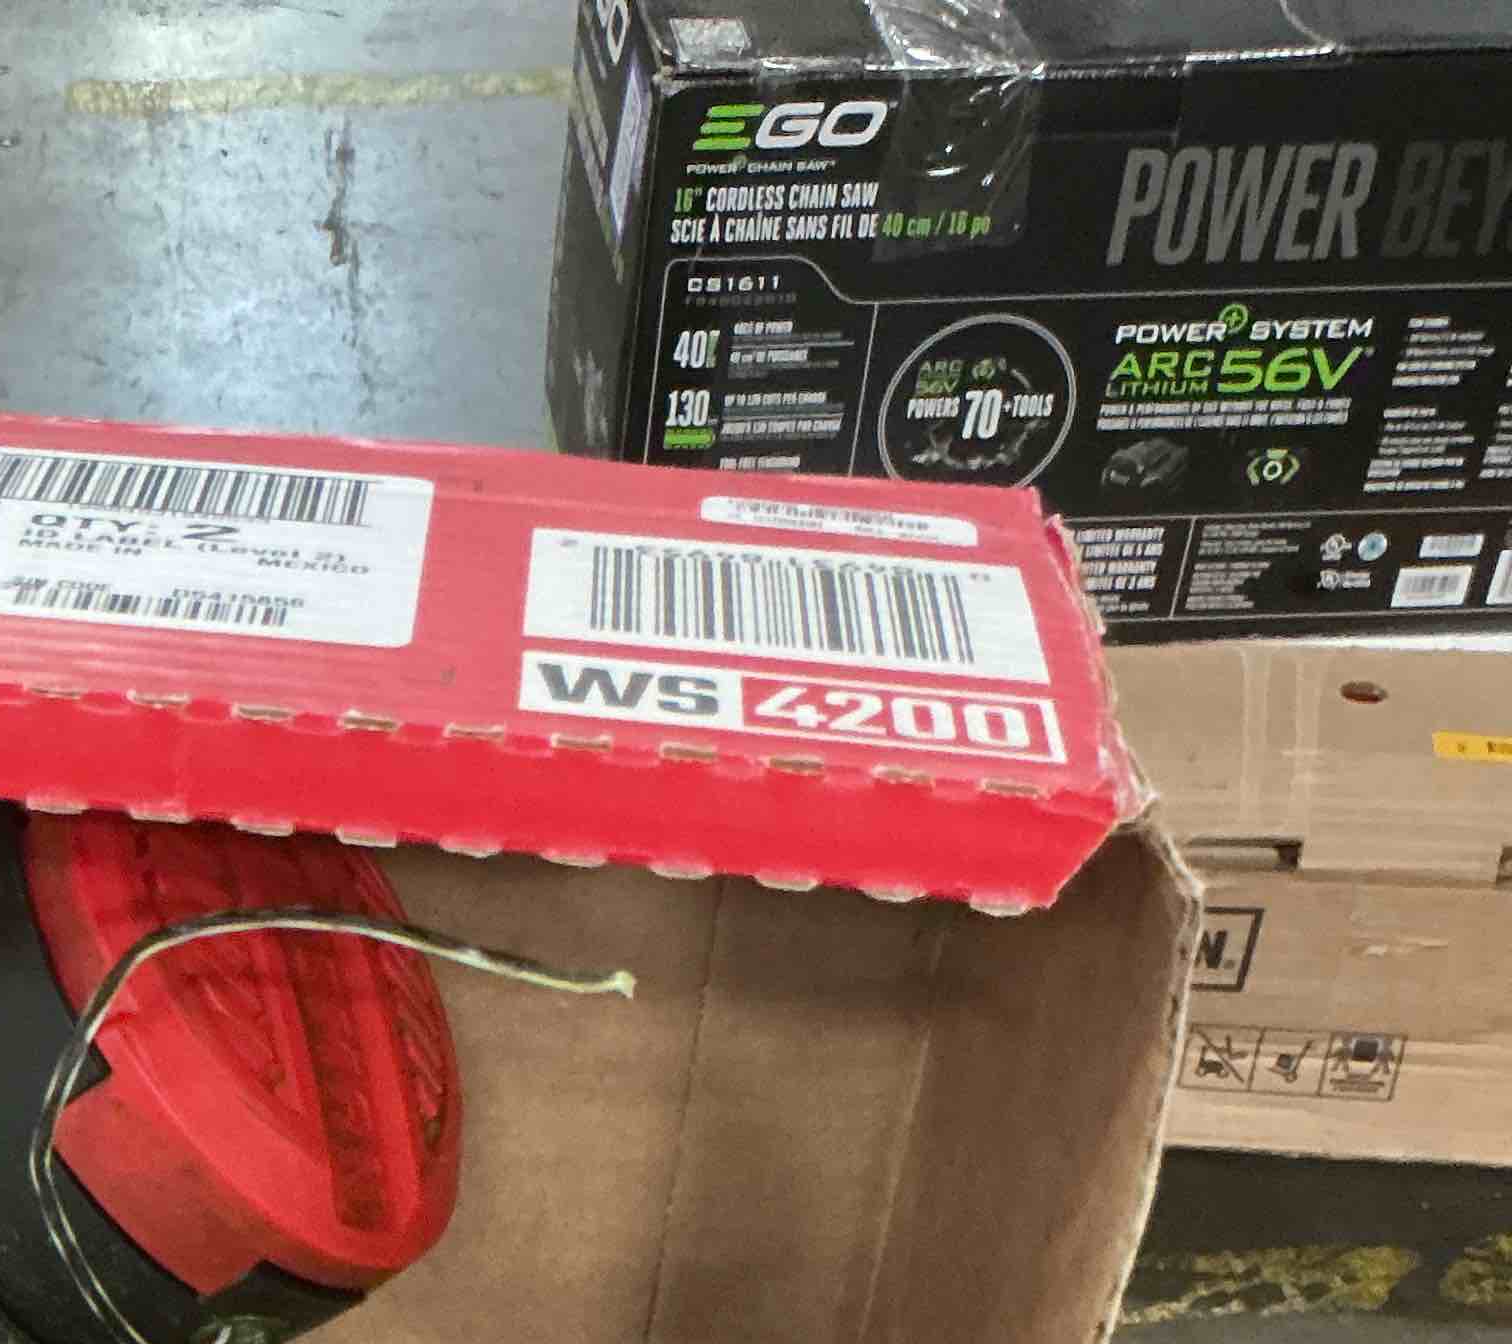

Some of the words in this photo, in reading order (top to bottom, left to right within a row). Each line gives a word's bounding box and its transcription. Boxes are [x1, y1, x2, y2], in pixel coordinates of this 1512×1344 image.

[692, 101, 889, 150] EGO
[705, 185, 786, 213] CORDLESS
[788, 183, 839, 210] CHAIN
[841, 182, 880, 207] SAW
[1106, 142, 1379, 267] POWER
[671, 218, 705, 244] SCIE
[709, 211, 721, 243] À
[723, 212, 782, 242] CHAÎNE
[785, 215, 829, 241] SANS
[831, 214, 854, 239] FIL
[857, 213, 880, 238] DE
[1249, 317, 1375, 341] SYSTEM
[1110, 350, 1216, 380] ARC
[1217, 346, 1364, 393] 56V
[1104, 380, 1209, 399] LITHIUM
[665, 389, 711, 427] 130
[907, 397, 961, 420] POWERS
[31, 513, 160, 534] QTY:
[182, 523, 242, 543] 2
[257, 557, 370, 575] MEXICO
[536, 661, 720, 718] WS
[753, 685, 1032, 751] 4200
